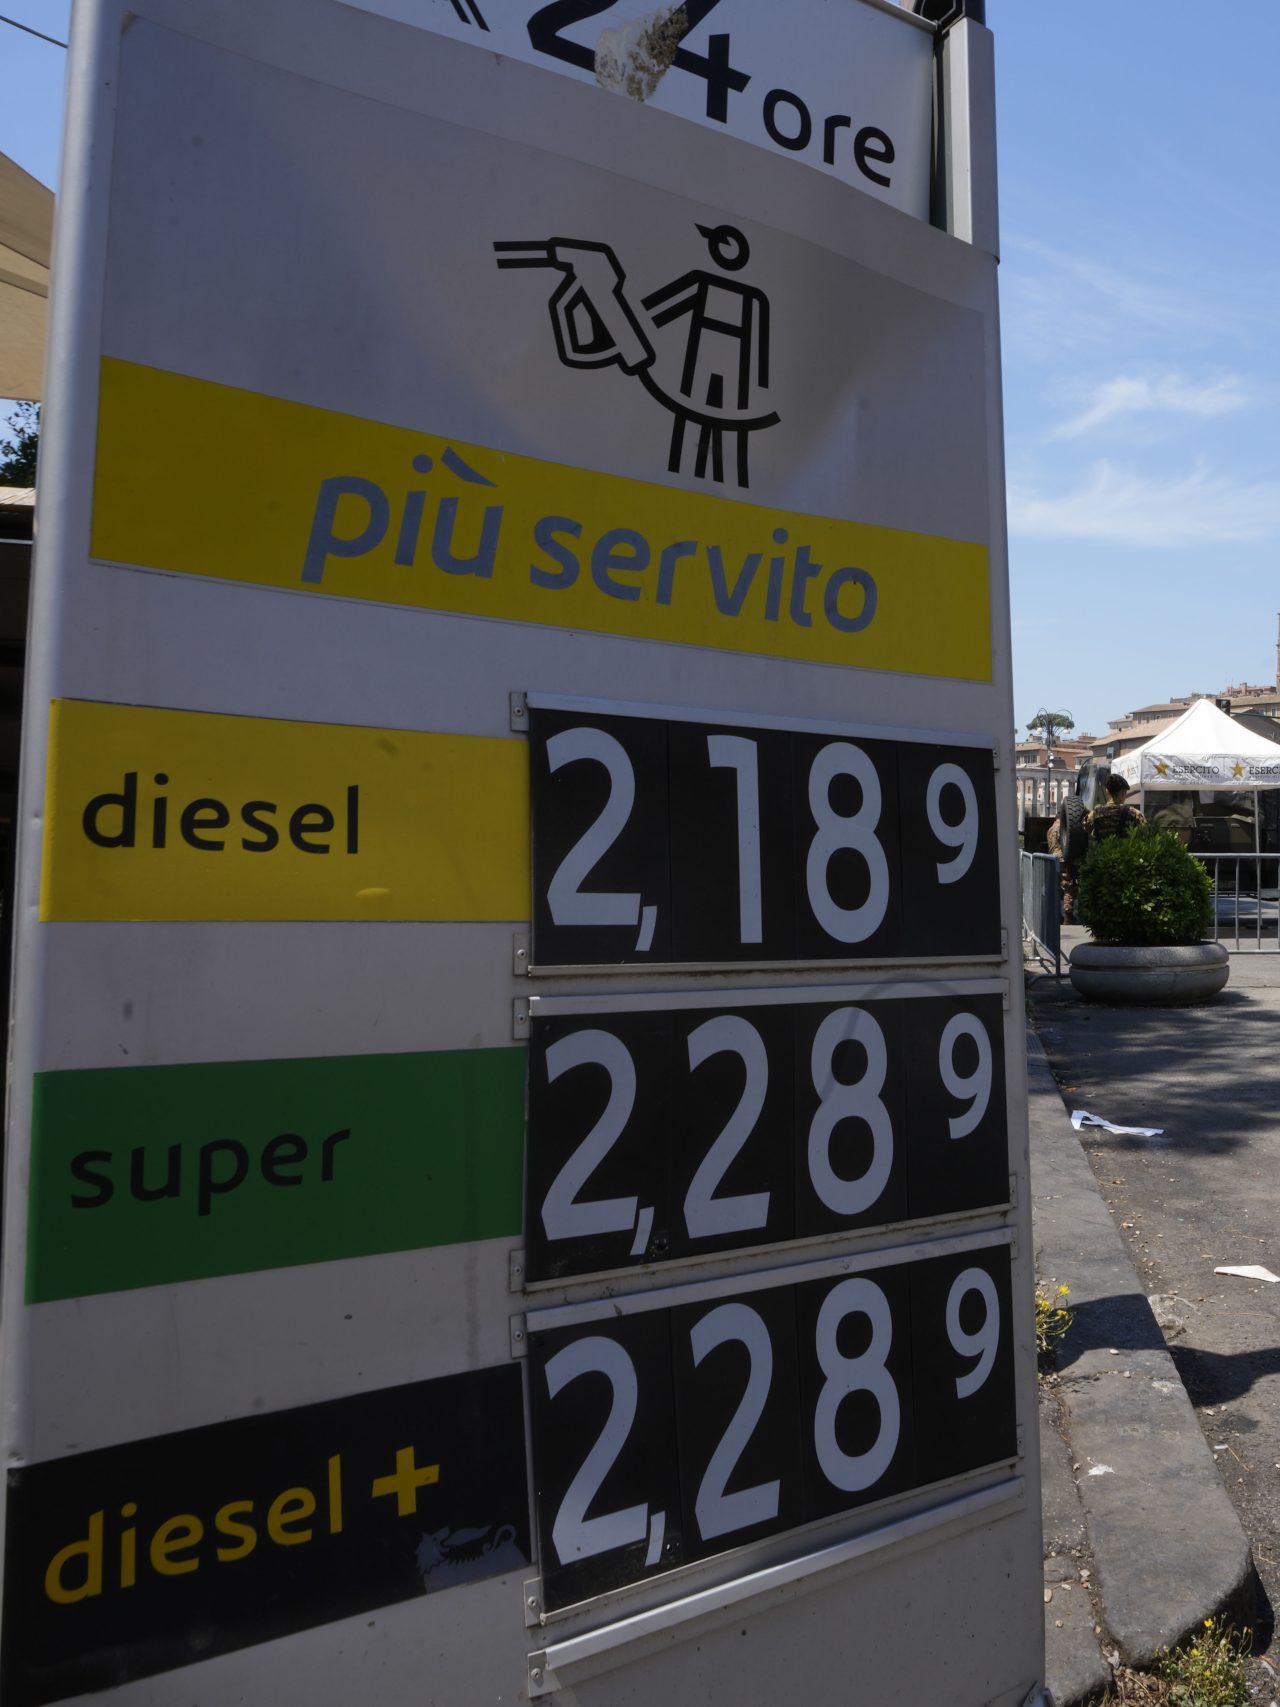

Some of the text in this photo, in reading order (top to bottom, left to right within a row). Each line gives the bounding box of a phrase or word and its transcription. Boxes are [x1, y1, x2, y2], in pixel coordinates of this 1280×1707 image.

[763, 88, 895, 188] ore
[300, 446, 878, 634] più servito
[1173, 765, 1220, 774] ESERCITO
[82, 772, 360, 855] diesel
[69, 1129, 351, 1216] super
